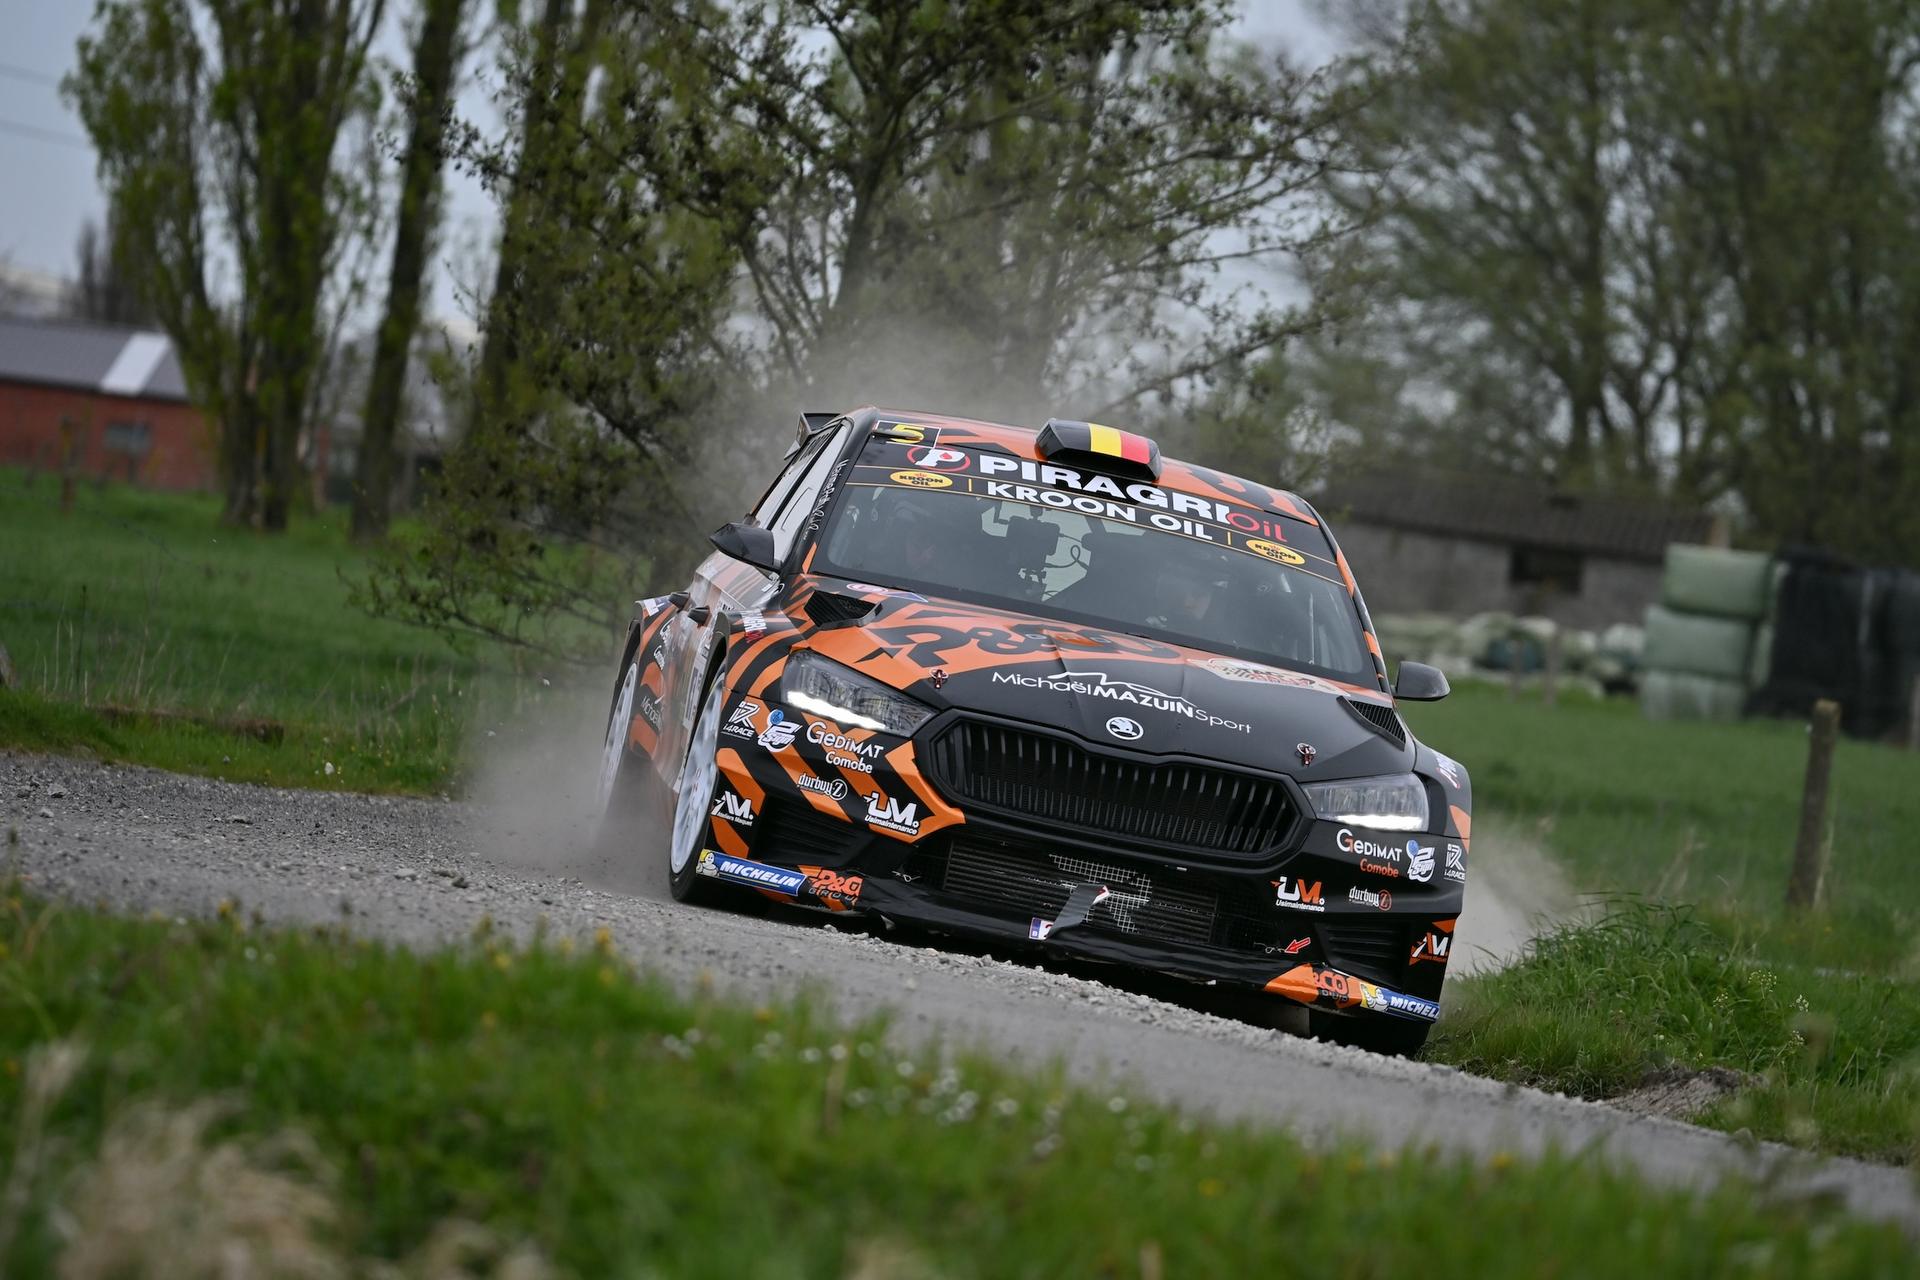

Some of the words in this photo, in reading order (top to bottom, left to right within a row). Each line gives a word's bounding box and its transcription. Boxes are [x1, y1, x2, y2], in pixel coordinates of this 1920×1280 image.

[891, 424, 924, 444] 5
[899, 475, 944, 484] KROON
[979, 454, 1230, 524] PIRAGRI
[1227, 512, 1288, 543] Oil
[987, 481, 1136, 522] KROON
[1150, 513, 1213, 540] OIL
[1255, 544, 1296, 560] KROON
[825, 751, 873, 774] Comobe
[798, 773, 833, 796] durbuy
[720, 860, 802, 888] MICHELIN
[1360, 858, 1399, 878] Comobe
[1348, 886, 1379, 907] durbuy
